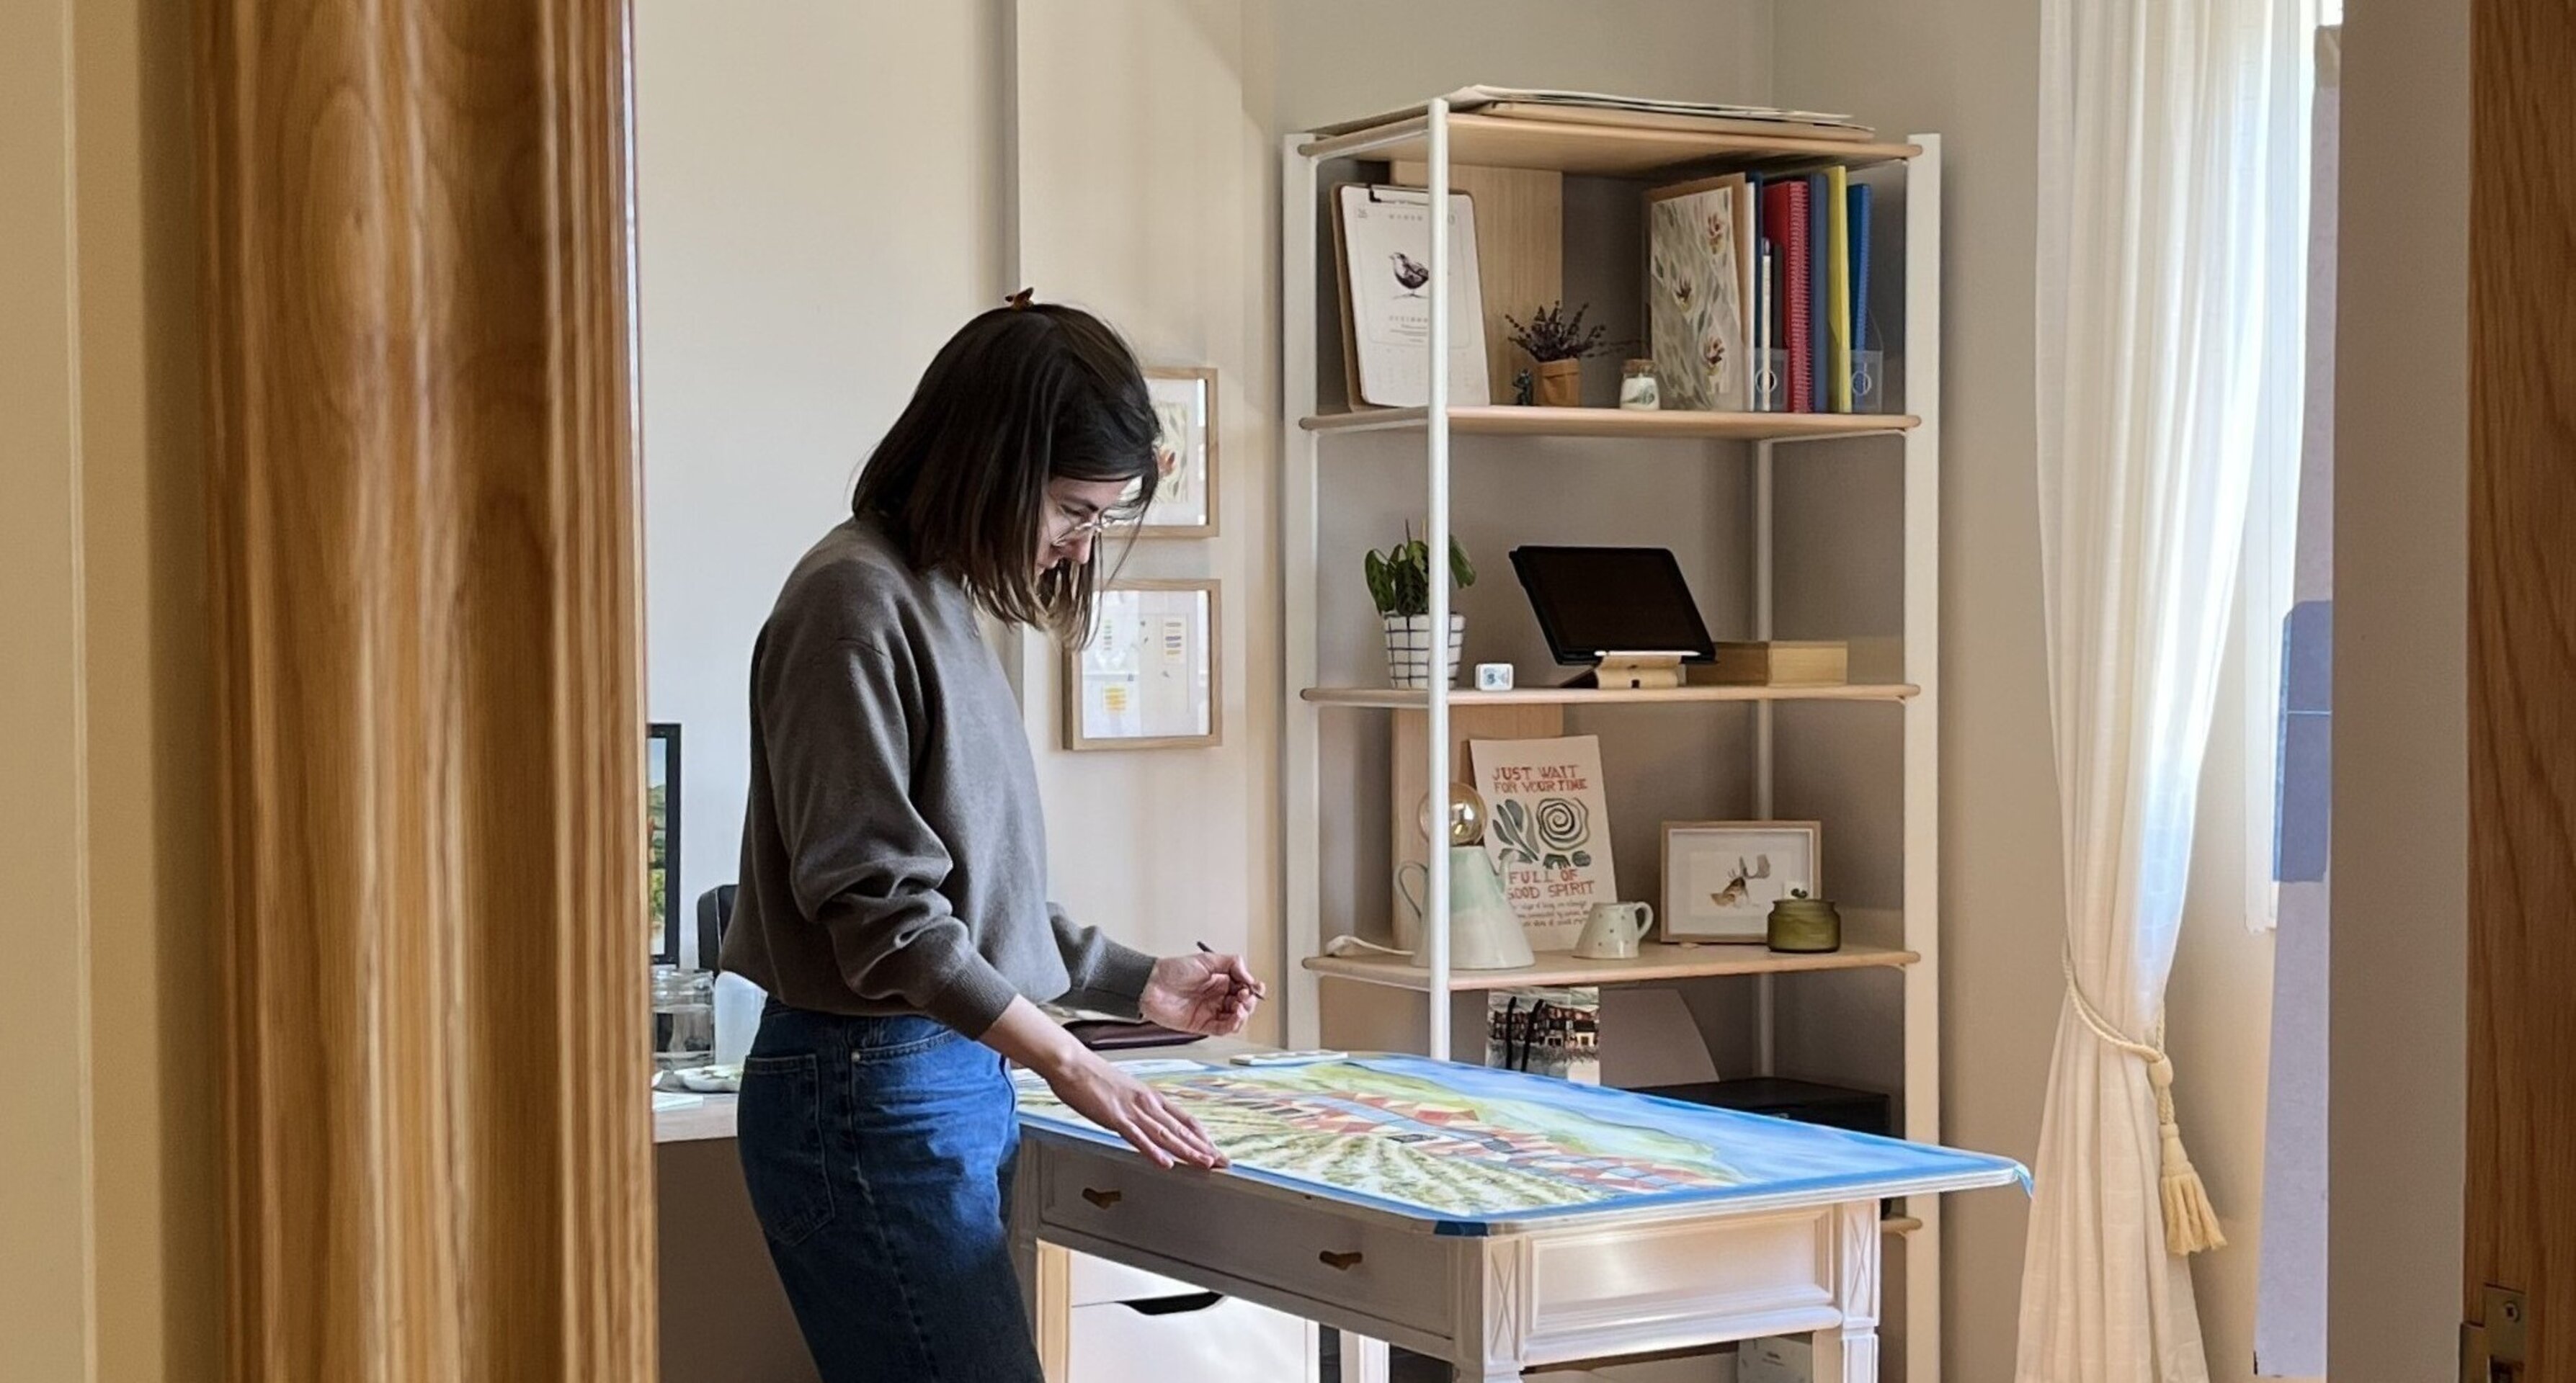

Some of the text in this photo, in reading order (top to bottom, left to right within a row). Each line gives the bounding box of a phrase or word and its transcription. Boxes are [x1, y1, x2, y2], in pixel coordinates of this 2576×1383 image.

[1492, 764, 1579, 780] JUST WAIT
[1494, 778, 1587, 793] FOR YOUR TIME
[1509, 868, 1578, 885] FULL OF
[1548, 880, 1595, 898] SPIRIT
